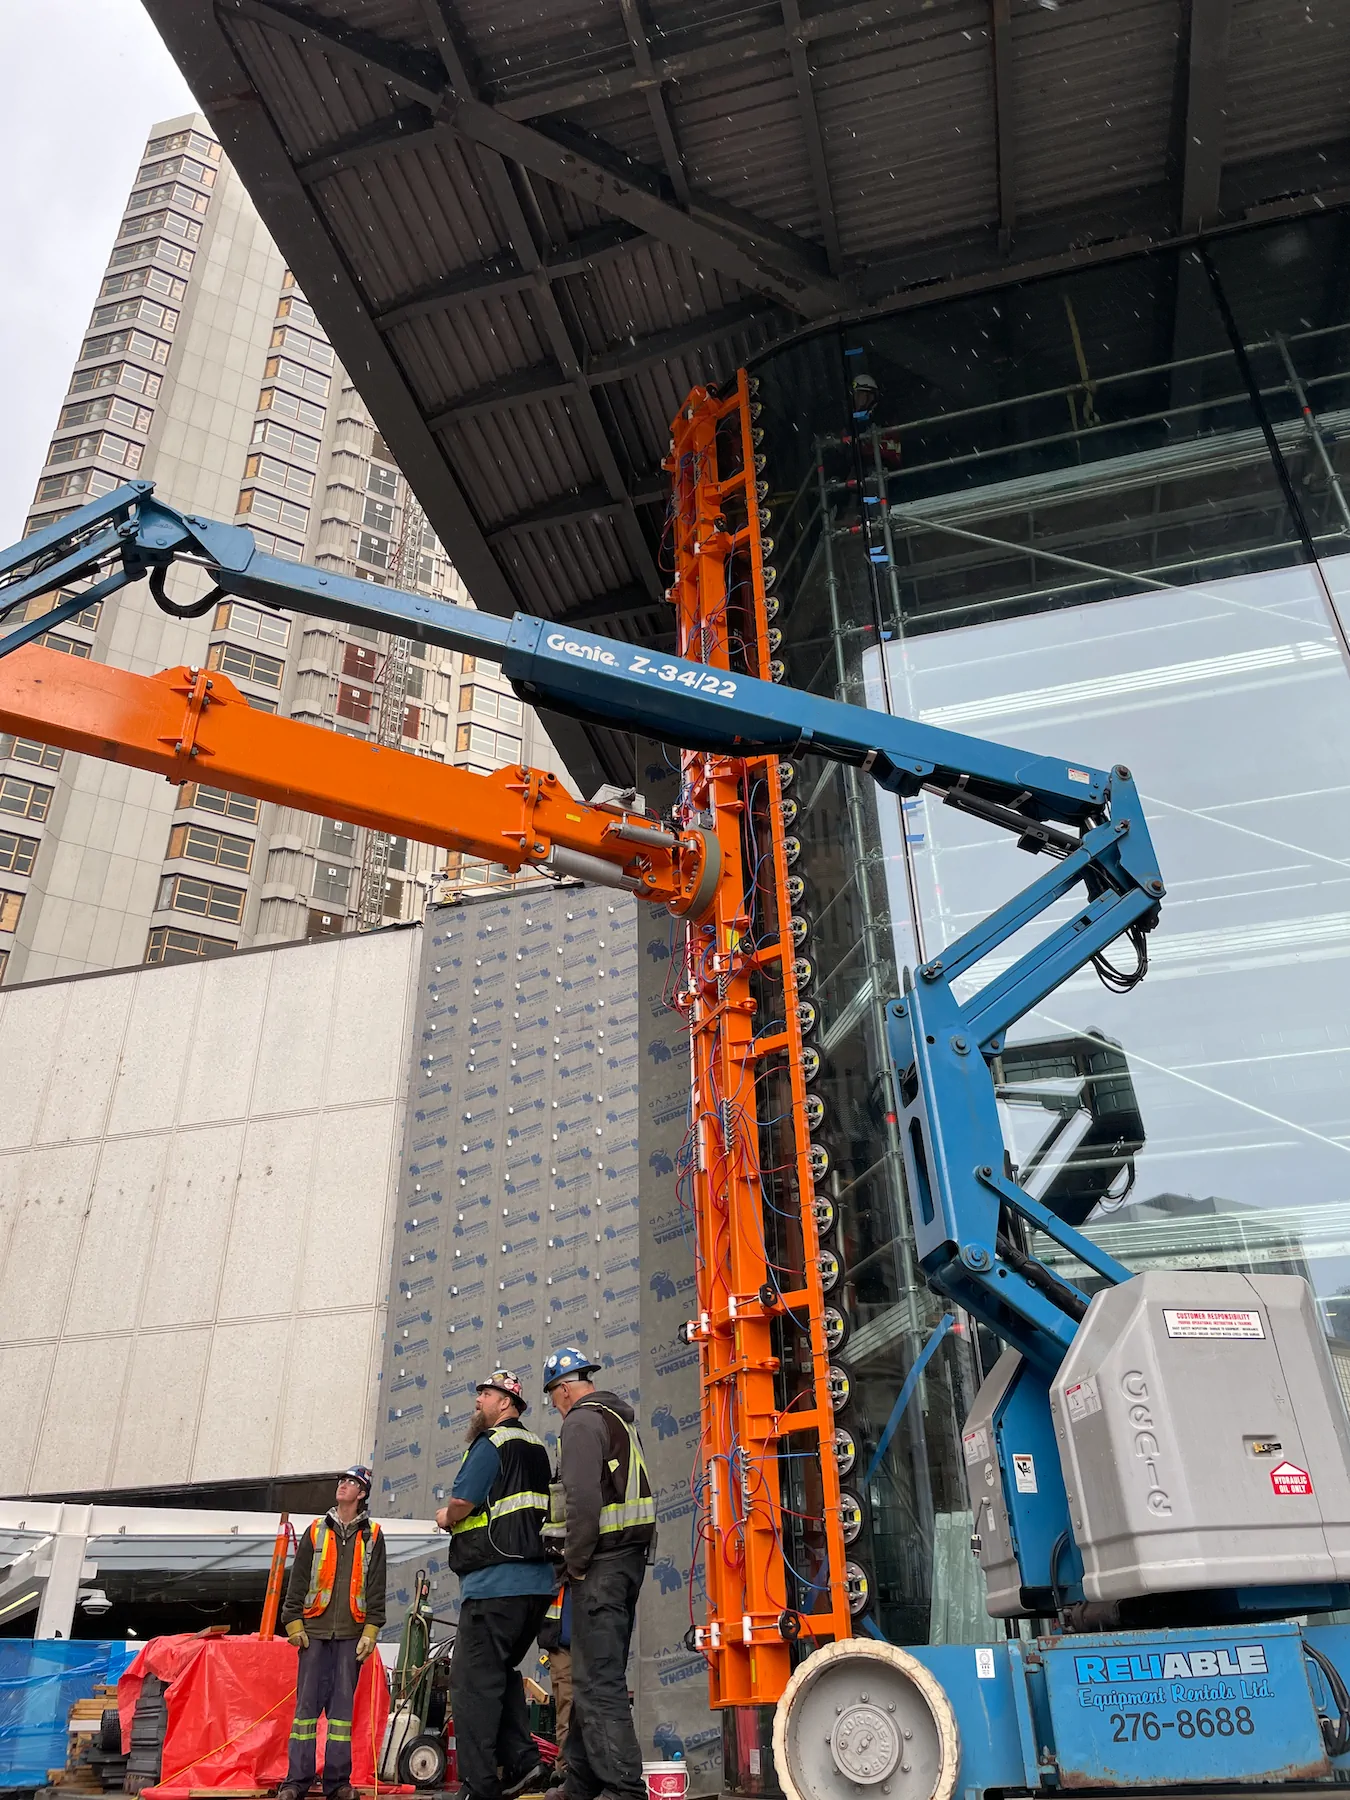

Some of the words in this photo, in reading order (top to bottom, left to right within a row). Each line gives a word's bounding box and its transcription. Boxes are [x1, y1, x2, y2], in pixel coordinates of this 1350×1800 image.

[547, 634, 615, 666] Genie
[628, 656, 737, 698] Z-34/22
[1176, 1312, 1206, 1320] CUSTOMER
[1208, 1312, 1250, 1320] RESPONSIBILITY
[650, 1344, 666, 1354] VP
[656, 1354, 699, 1376] OPREMA
[1121, 1370, 1172, 1516] Genie
[1274, 1476, 1308, 1484] HYDRAULIC
[1279, 1485, 1290, 1493] OIL
[1291, 1485, 1306, 1493] ONLY
[654, 1647, 671, 1659] VP
[1074, 1644, 1268, 1684] RELIABLE
[660, 1660, 708, 1686] OPREMA
[1078, 1682, 1164, 1712] Equipment
[1171, 1680, 1236, 1704] Rentals
[1240, 1679, 1276, 1700] Ltd.
[1110, 1706, 1255, 1743] 276-8688
[694, 1756, 722, 1775] STIC
